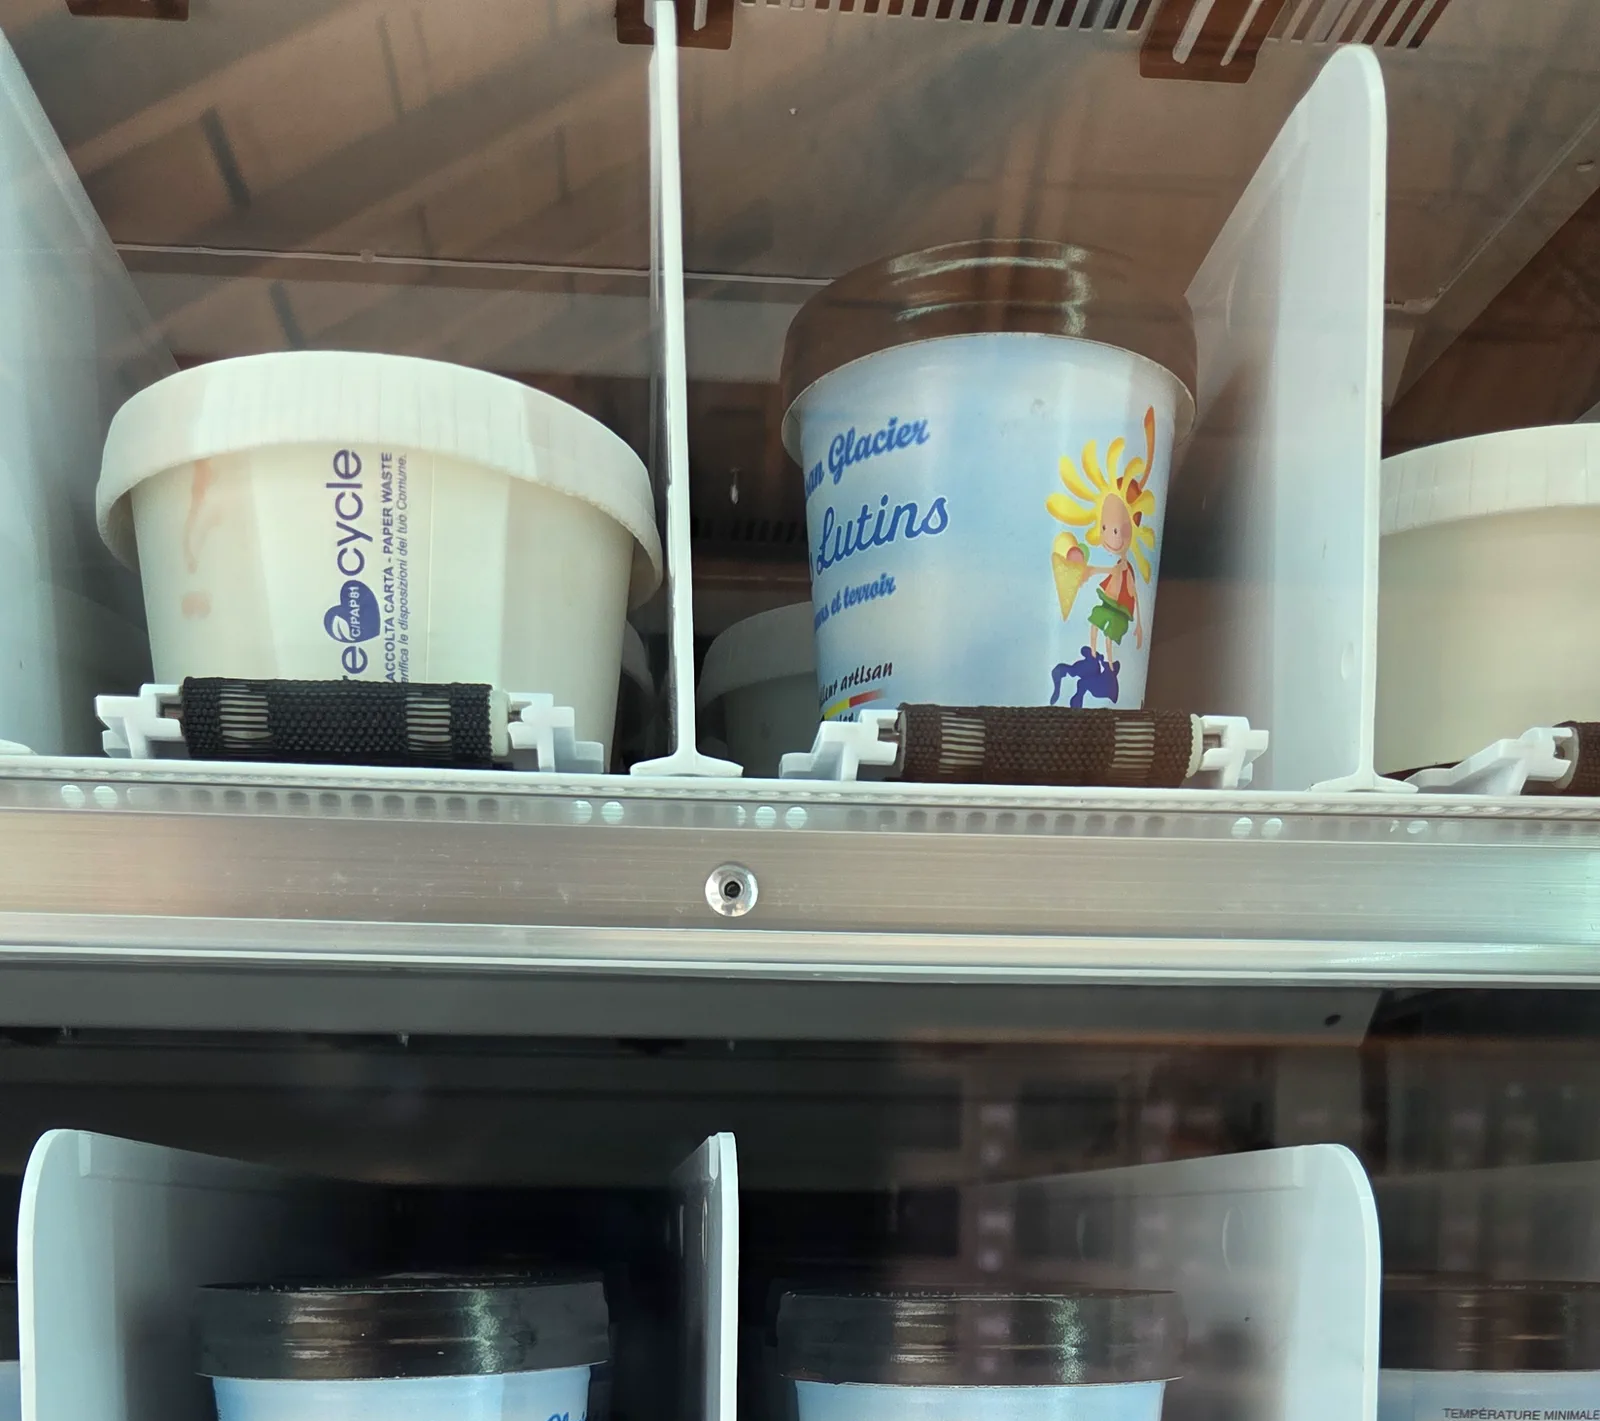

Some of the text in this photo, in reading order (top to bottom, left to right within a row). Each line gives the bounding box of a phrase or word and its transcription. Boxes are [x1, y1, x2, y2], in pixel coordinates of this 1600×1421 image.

[828, 416, 930, 485] Glacier
[381, 452, 393, 503] WASTE
[382, 507, 393, 554] PAPER
[397, 538, 408, 556] del
[815, 494, 949, 577] Lutins
[383, 566, 395, 613] CARTA
[397, 559, 410, 630] disposizioni
[831, 590, 841, 616] et
[843, 572, 897, 609] terroir
[398, 633, 408, 645] le
[840, 662, 893, 691] artisan
[1443, 1408, 1600, 1421] TEMPÉRATURE MINIMALE
